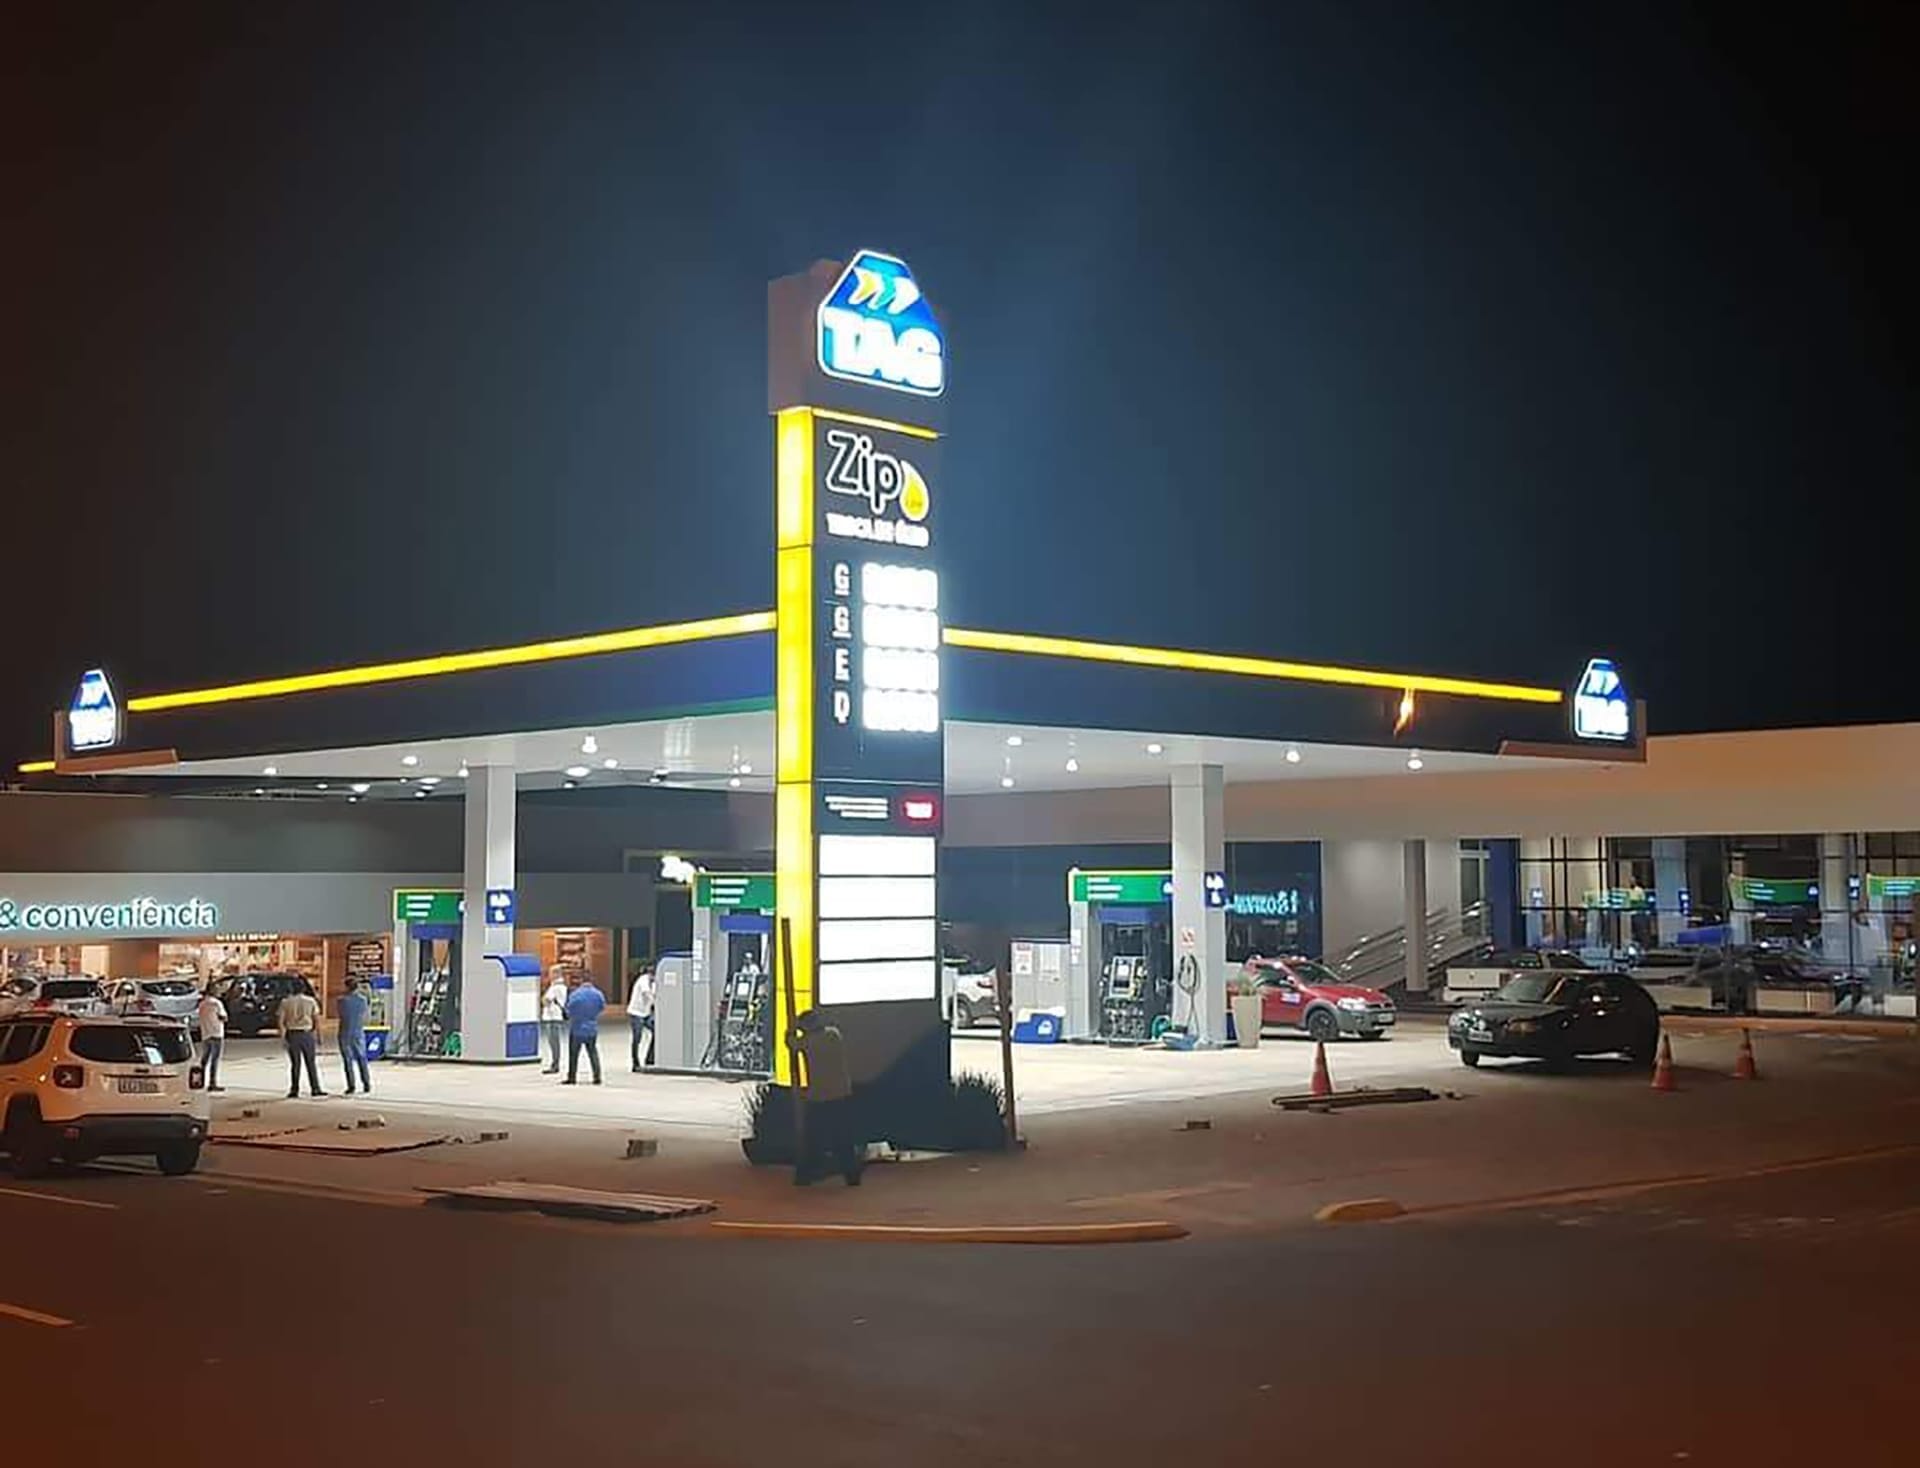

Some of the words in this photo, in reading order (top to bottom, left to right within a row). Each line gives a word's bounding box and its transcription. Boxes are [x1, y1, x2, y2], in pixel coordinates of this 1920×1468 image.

[824, 307, 942, 388] TAG
[826, 430, 902, 513] Zip
[23, 896, 218, 929] conveniência
